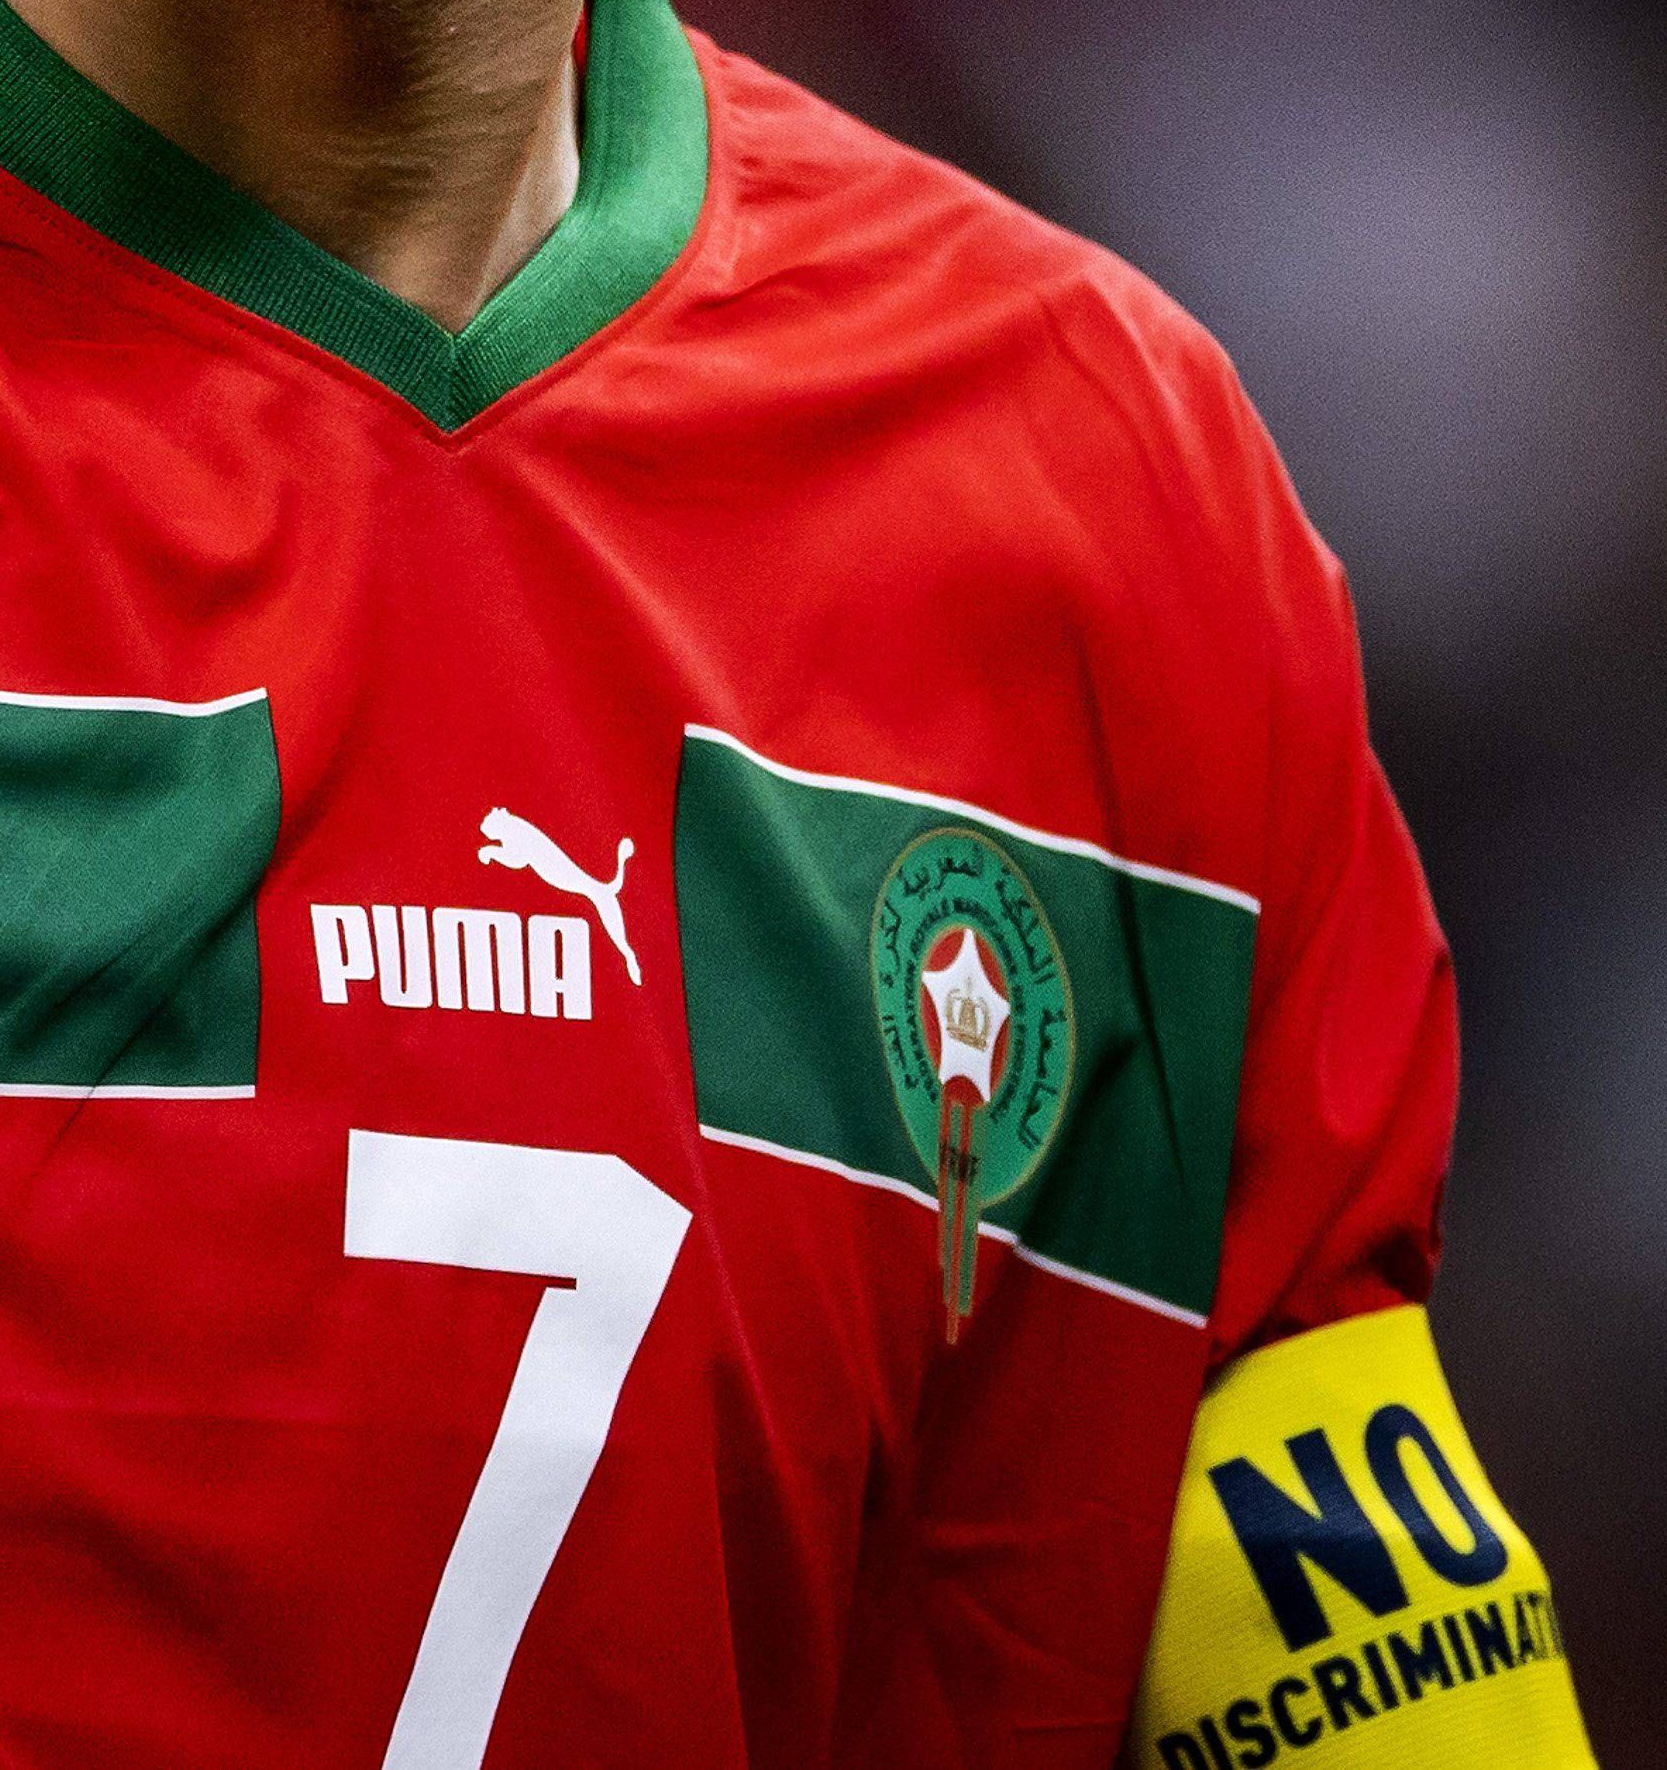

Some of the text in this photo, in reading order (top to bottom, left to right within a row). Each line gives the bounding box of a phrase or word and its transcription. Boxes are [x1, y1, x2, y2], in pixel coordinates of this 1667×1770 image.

[310, 903, 593, 1021] PUMA
[343, 1128, 694, 1770] 7
[1207, 1403, 1509, 1654] NO
[1156, 1591, 1560, 1770] DISCRIMINAT
